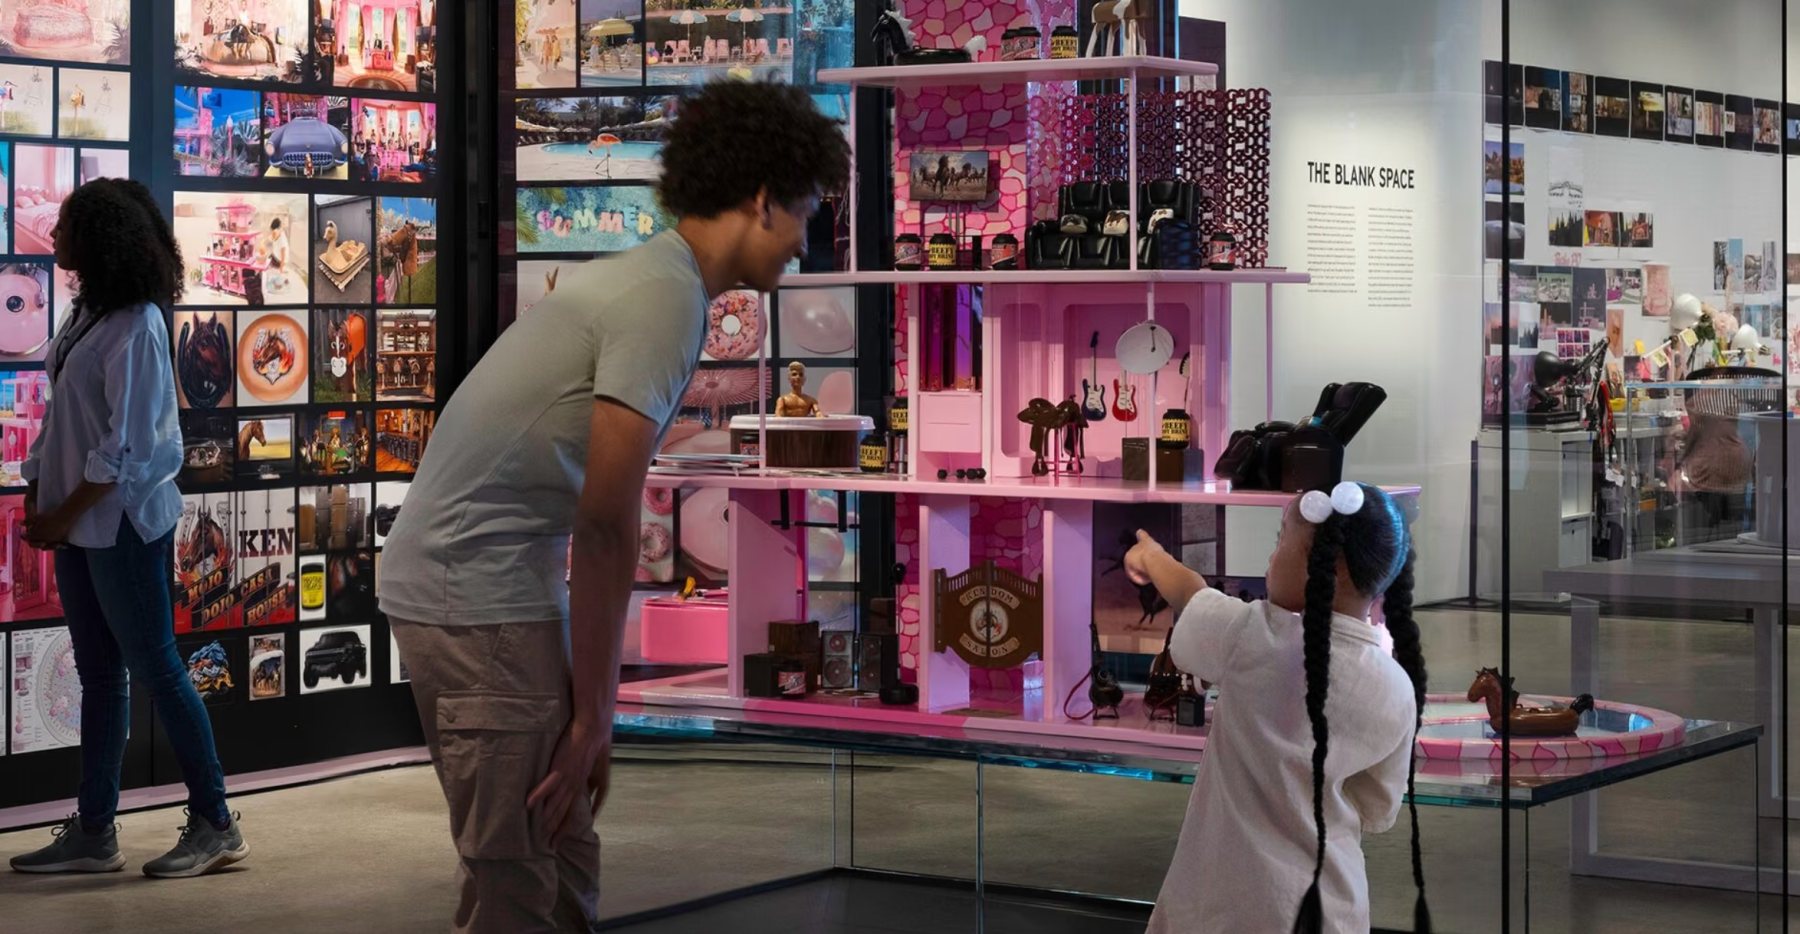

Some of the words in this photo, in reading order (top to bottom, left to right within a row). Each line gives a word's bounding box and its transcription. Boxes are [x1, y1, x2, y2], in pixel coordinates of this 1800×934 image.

[1307, 161, 1331, 184] THE
[1335, 163, 1375, 187] BLANK
[1379, 166, 1415, 189] SPACE
[537, 206, 654, 237] SUMMER
[239, 527, 294, 558] KEN
[188, 570, 223, 603] MOJO
[203, 593, 235, 622] DOJO
[246, 587, 287, 624] HOUSE
